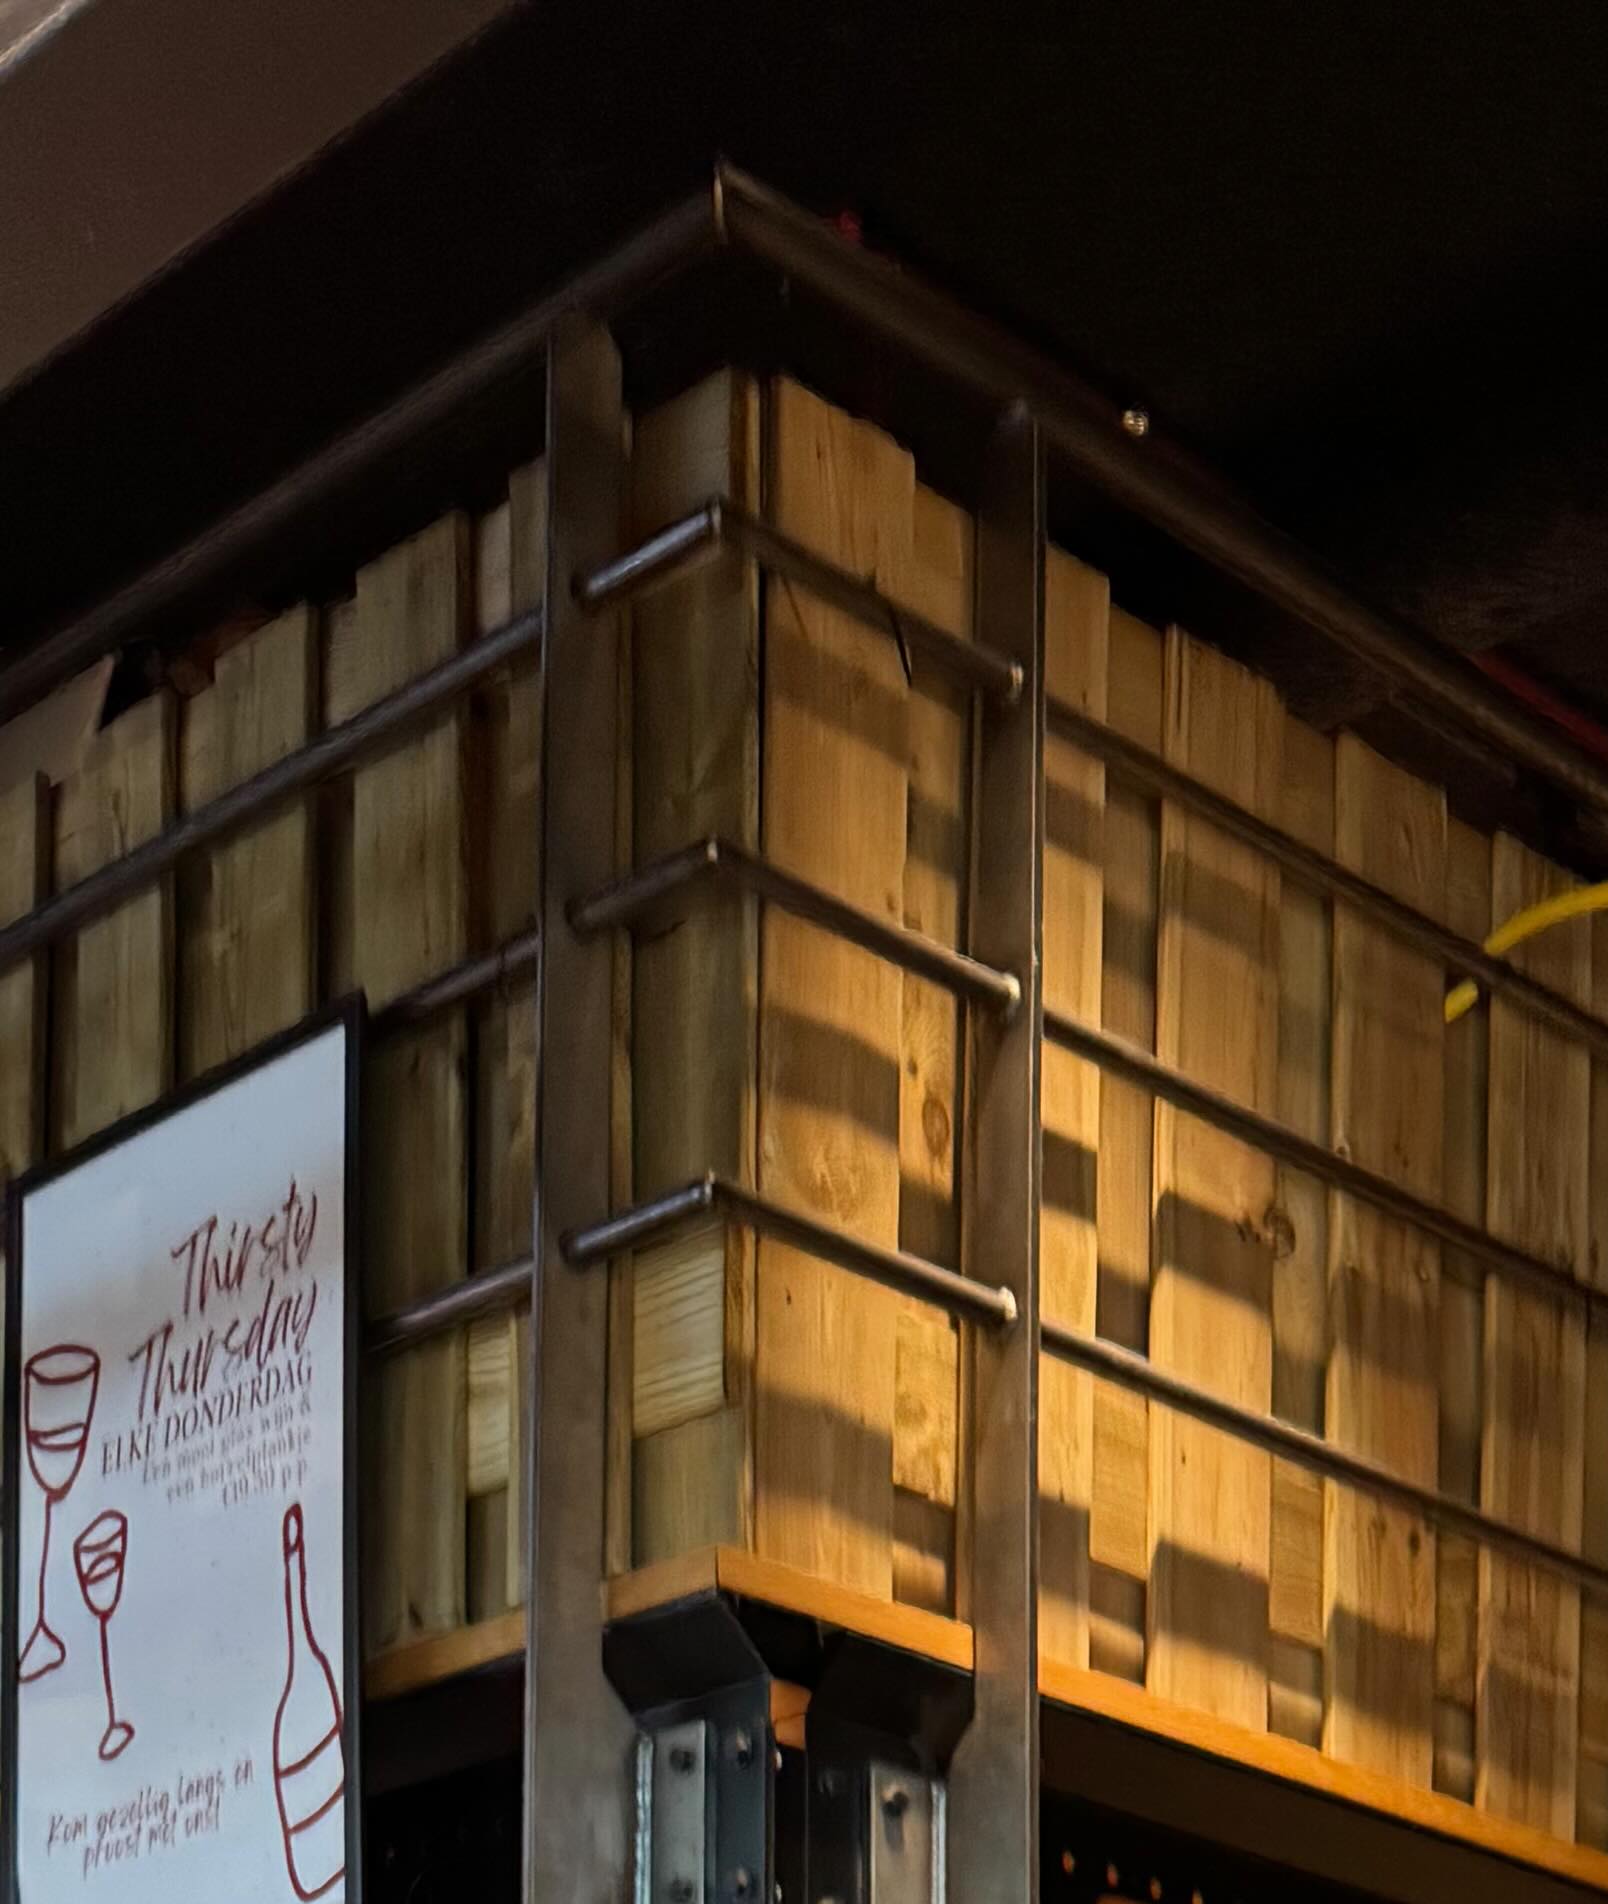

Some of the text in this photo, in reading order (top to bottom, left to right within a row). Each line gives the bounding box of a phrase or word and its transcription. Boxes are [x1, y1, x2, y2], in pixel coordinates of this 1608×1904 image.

[170, 1174, 318, 1319] Thirsty
[128, 1277, 318, 1420] Thursday
[101, 1351, 312, 1478] ELKE DONDERDAG
[47, 1757, 255, 1857] Kom gezellig langs en
[82, 1820, 142, 1880] proost
